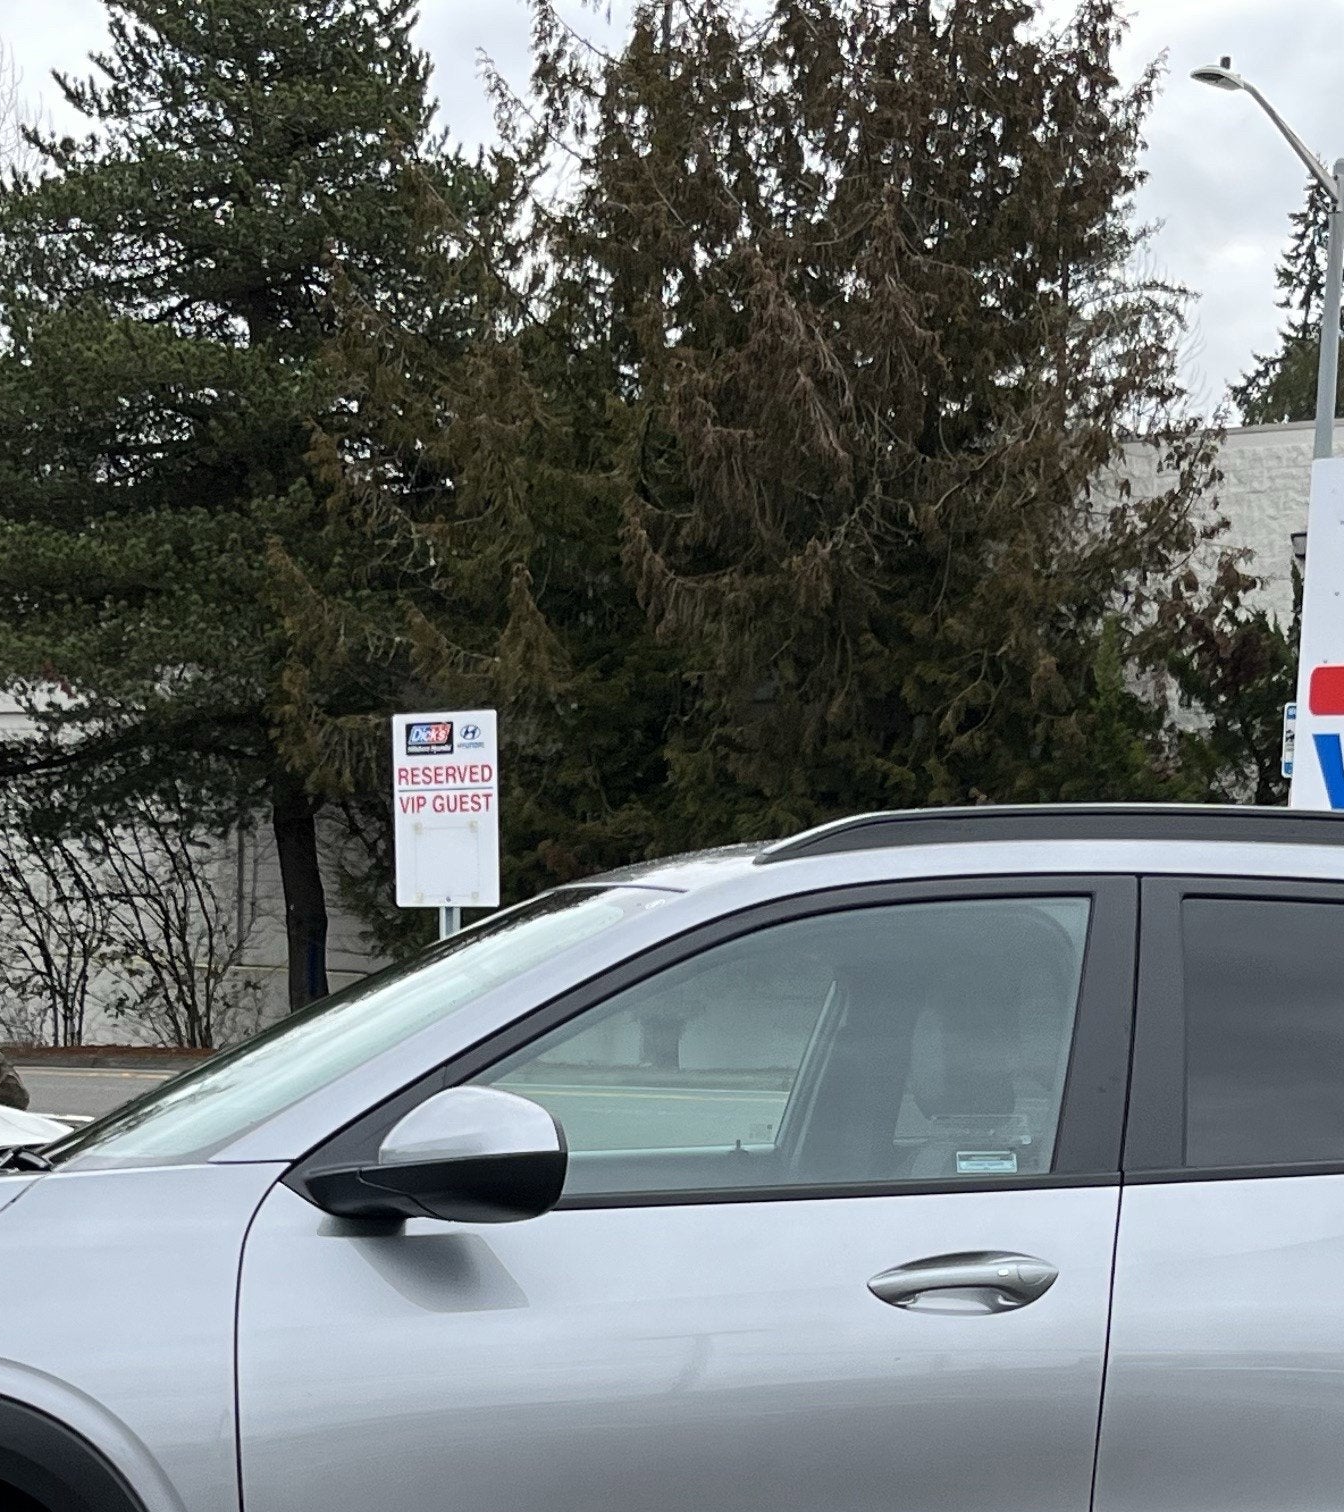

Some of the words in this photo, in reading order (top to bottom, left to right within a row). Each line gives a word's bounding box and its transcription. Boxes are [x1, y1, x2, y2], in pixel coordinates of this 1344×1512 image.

[398, 764, 493, 785] RESERVED
[399, 795, 427, 814] VIP
[432, 793, 493, 813] GUEST
